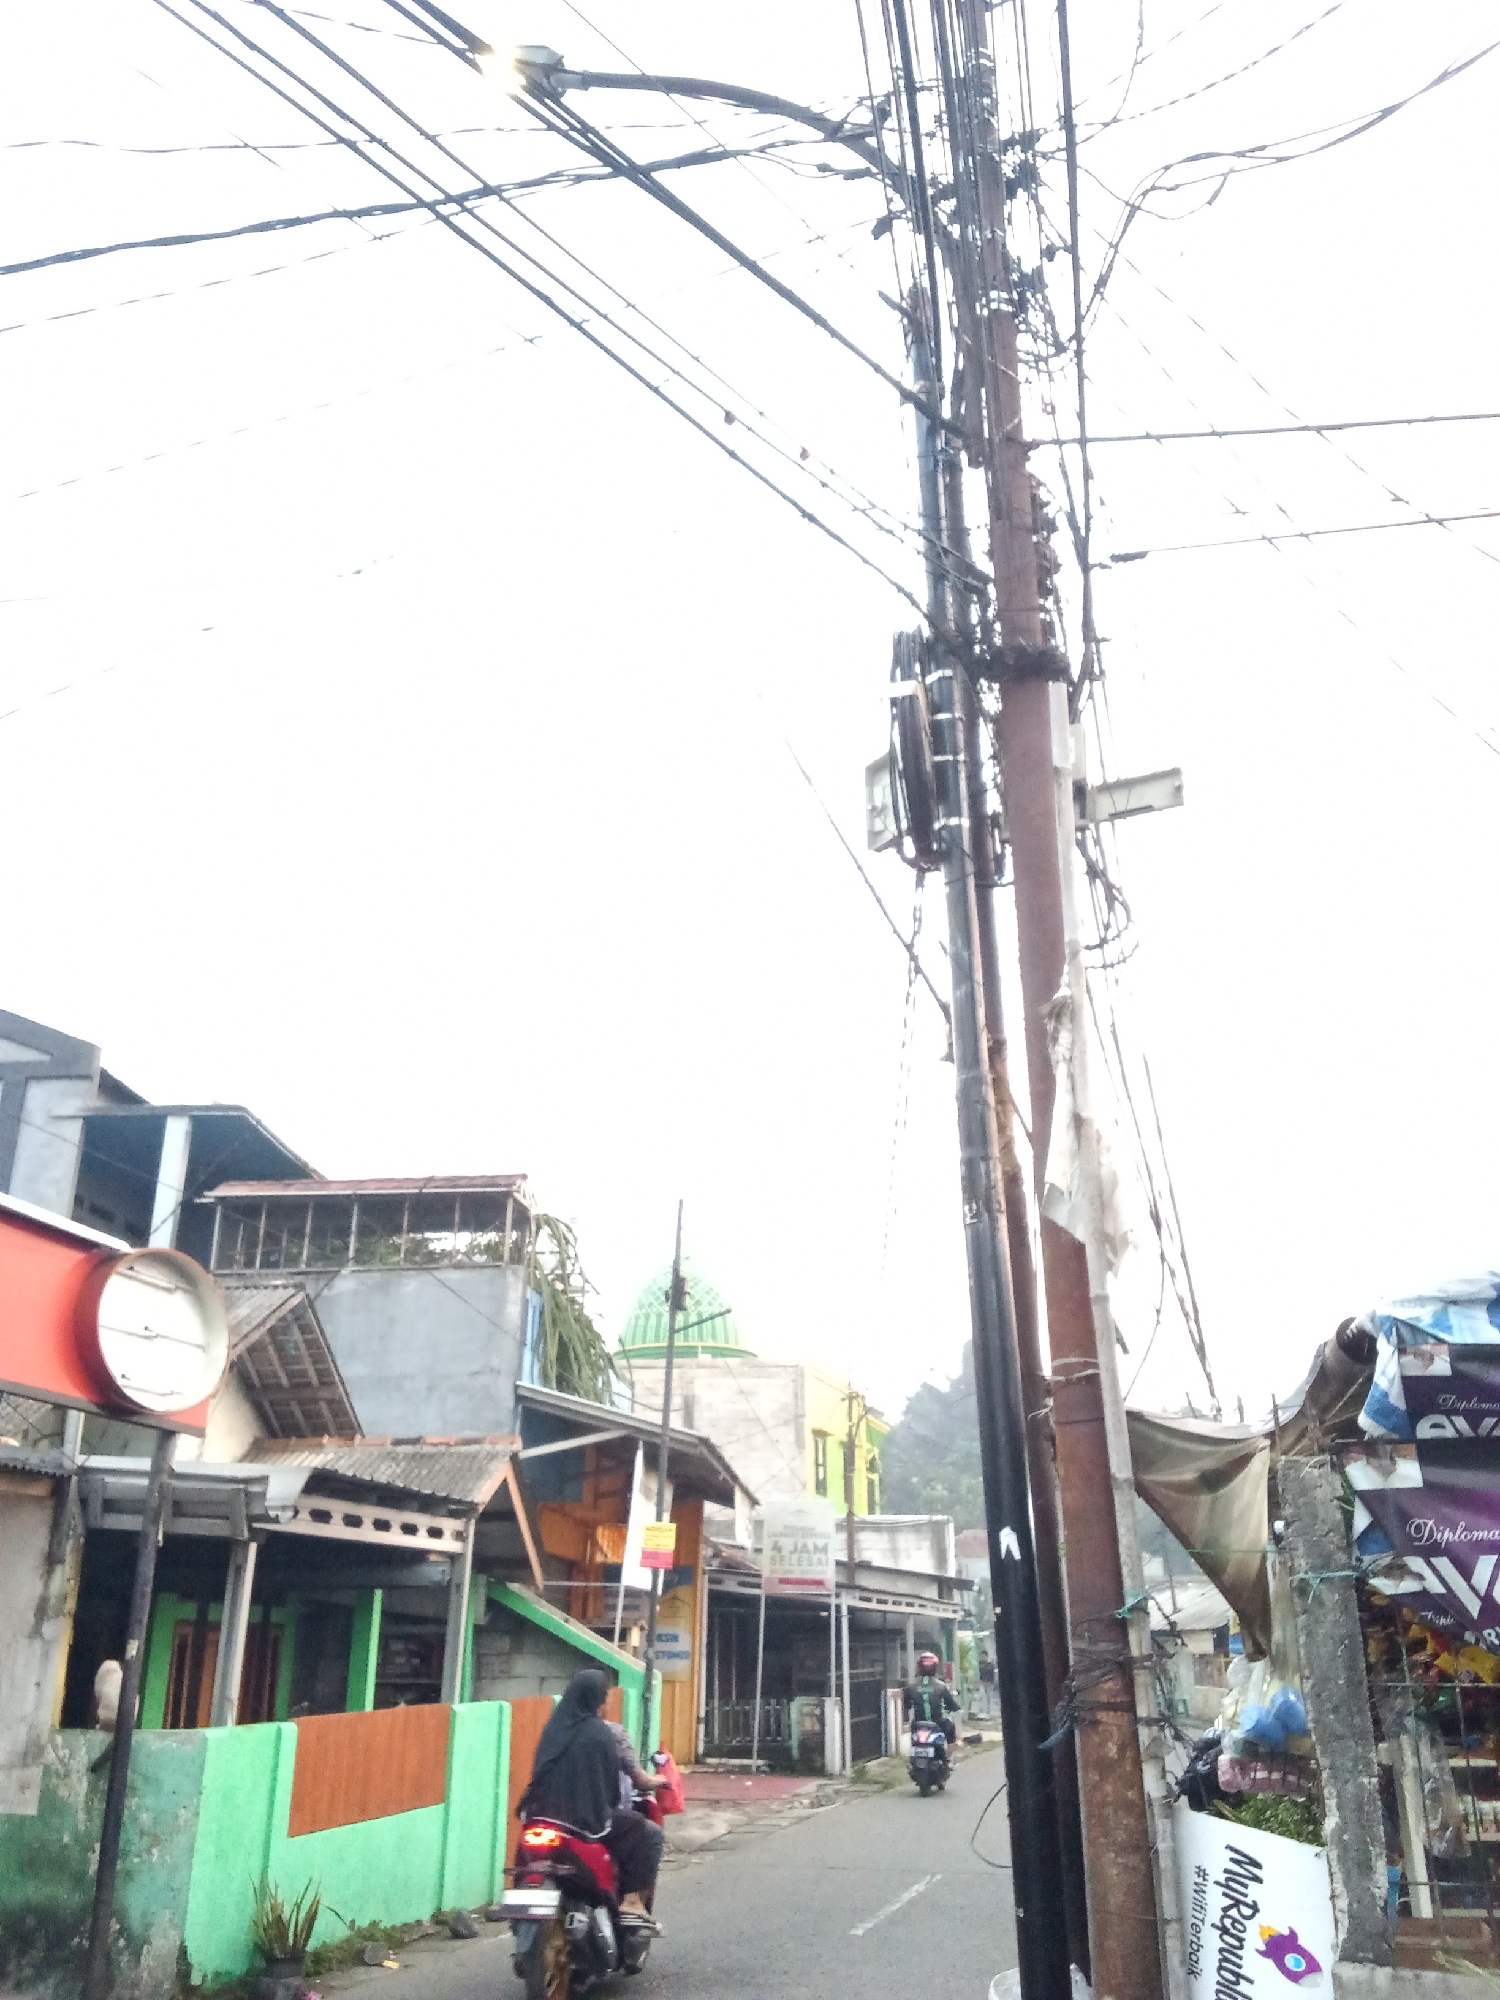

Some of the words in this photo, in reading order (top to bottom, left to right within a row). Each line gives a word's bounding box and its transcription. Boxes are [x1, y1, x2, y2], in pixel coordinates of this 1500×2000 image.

[770, 1540, 782, 1554] 4
[789, 1541, 829, 1555] JAM
[770, 1555, 829, 1567] SELESAI
[1186, 1865, 1210, 1982] #WifiTerbaik
[1210, 1843, 1264, 2000] MyRepubli
